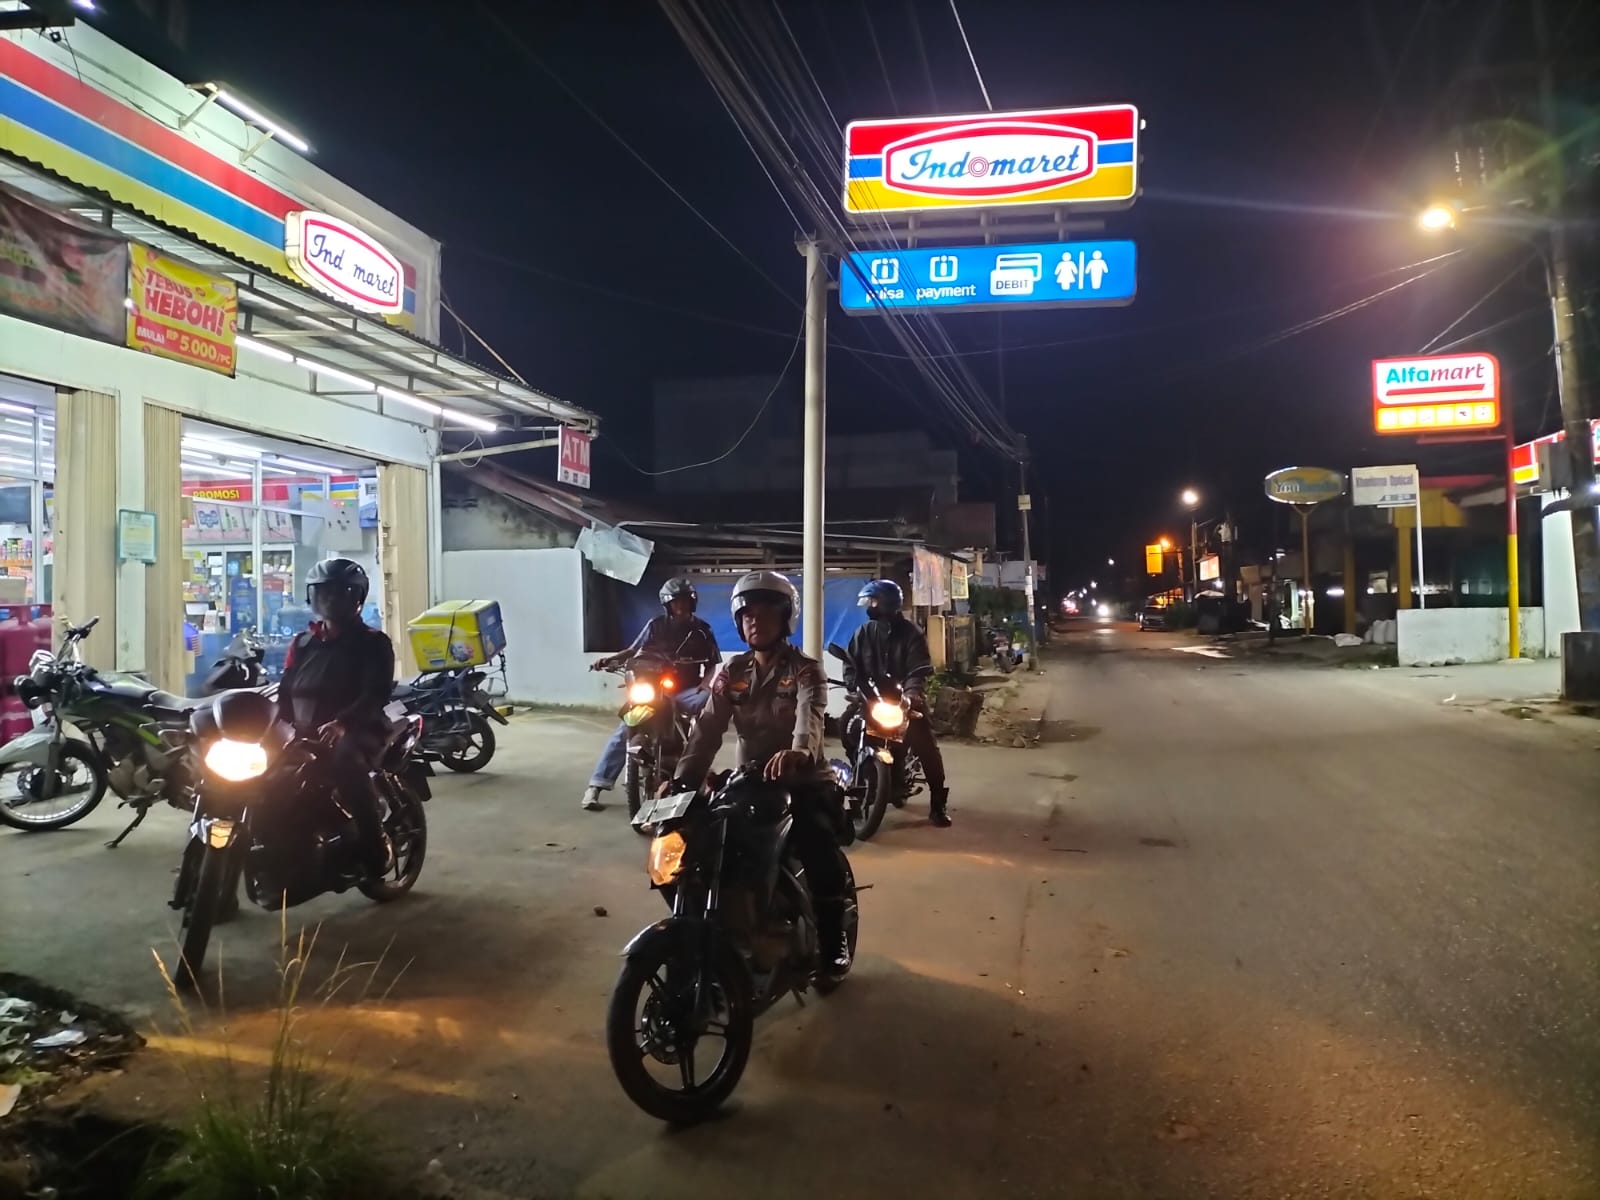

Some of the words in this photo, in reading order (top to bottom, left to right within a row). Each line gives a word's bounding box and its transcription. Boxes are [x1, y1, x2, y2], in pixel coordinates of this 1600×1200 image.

[901, 145, 1080, 180] Indomaret
[145, 267, 193, 299] TEBUS
[916, 284, 977, 302] payment
[995, 279, 1029, 290] DEBIT
[144, 288, 225, 337] HEBOH!
[136, 326, 165, 344] MULAI
[1386, 363, 1485, 384] Alfamart
[562, 433, 590, 467] ATM
[193, 489, 240, 499] PROMOSI
